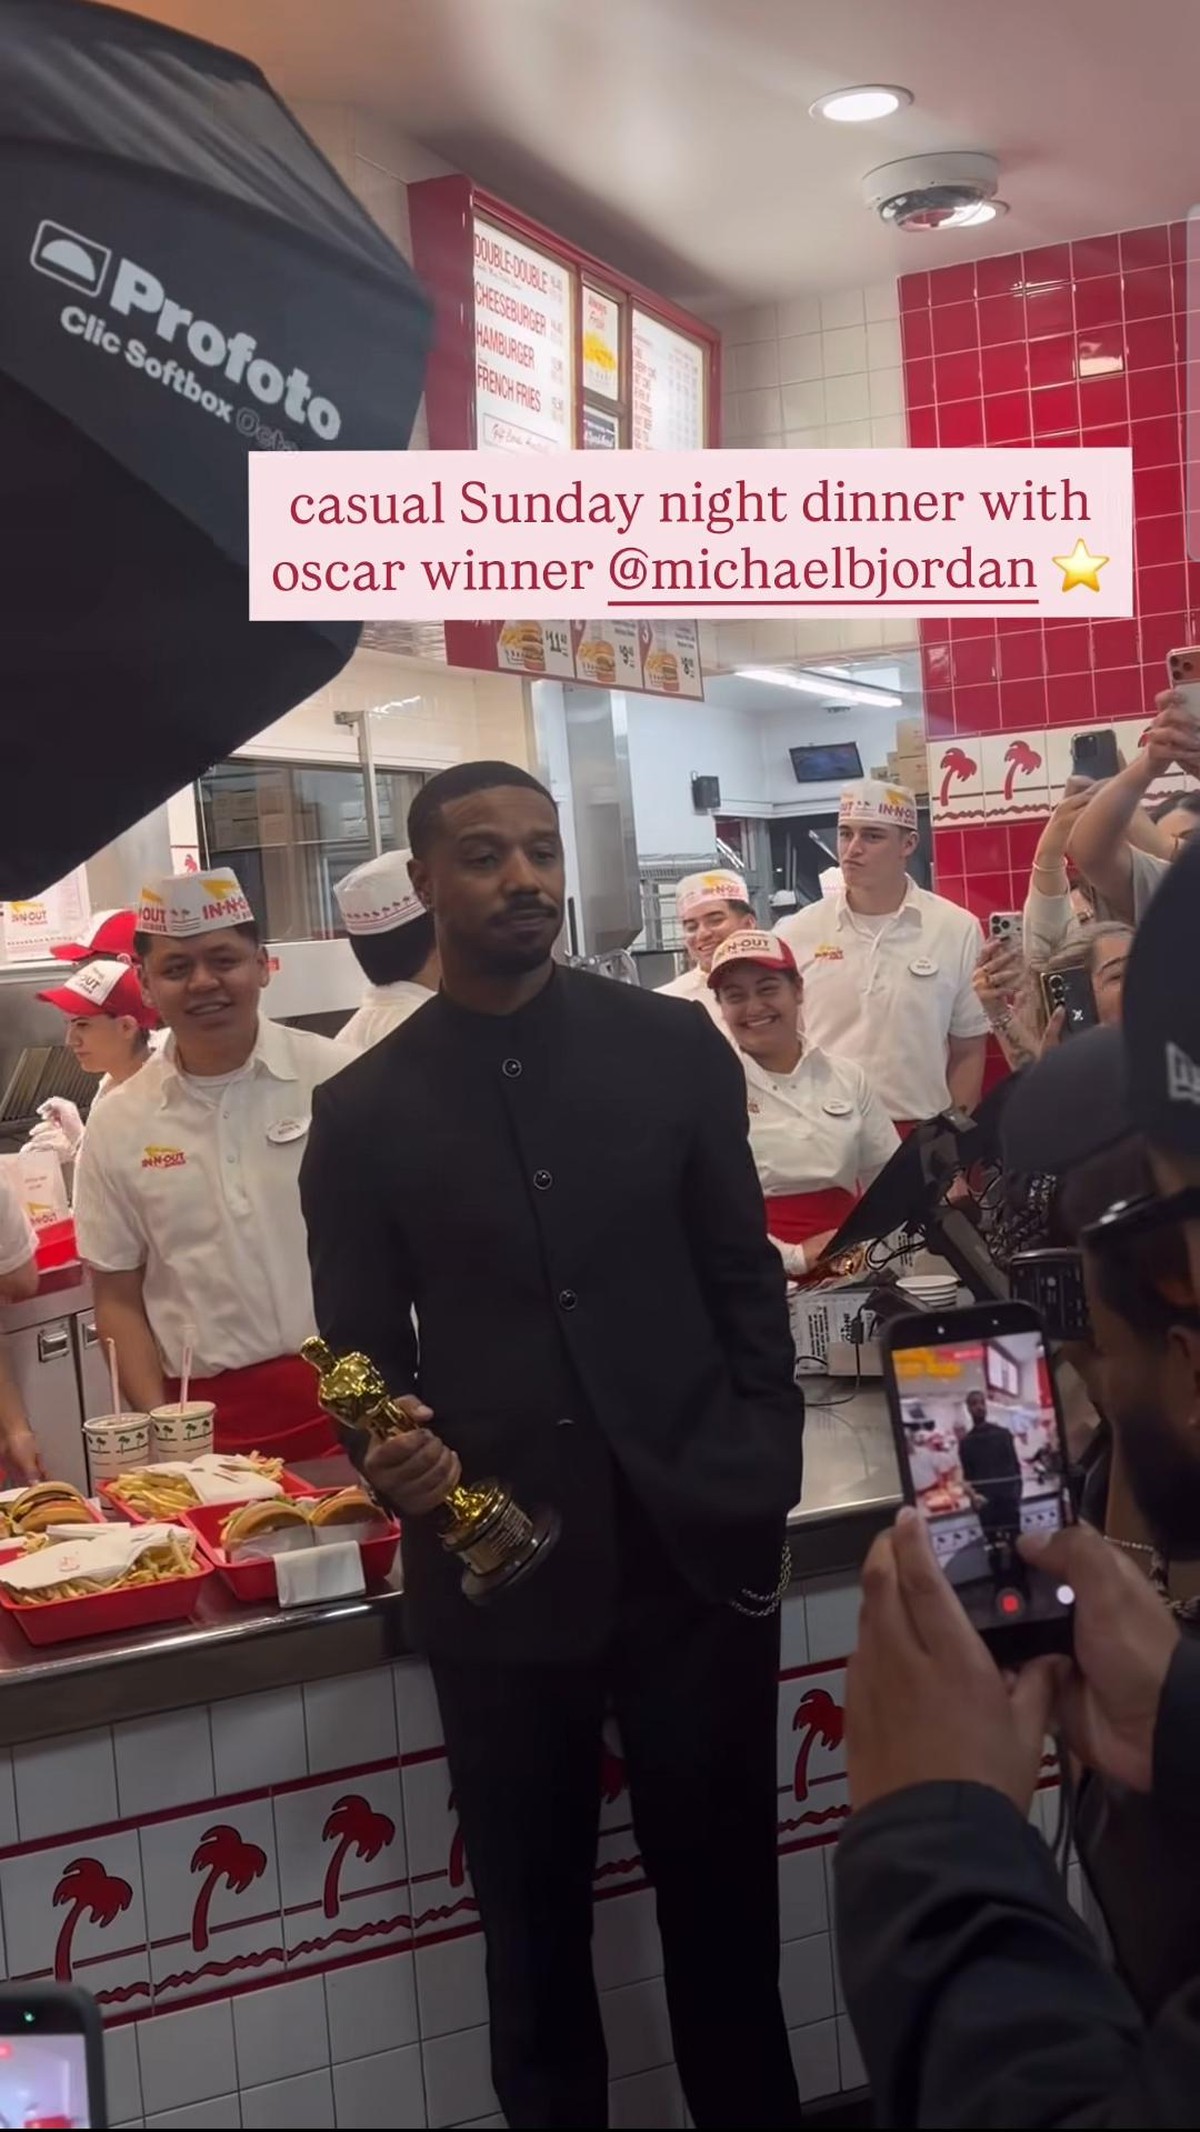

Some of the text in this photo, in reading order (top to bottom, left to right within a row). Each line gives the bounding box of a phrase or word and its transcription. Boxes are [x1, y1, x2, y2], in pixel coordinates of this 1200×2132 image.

[475, 234, 549, 294] DOUBLE-DOUBLE
[475, 281, 548, 336] CHEESEBURGER
[61, 307, 121, 354] Clic
[125, 340, 233, 423] Softbox
[110, 258, 342, 440] Profoto
[476, 320, 535, 370] HAMBURGER
[477, 364, 514, 401] FRENCH
[516, 381, 541, 412] FRIES
